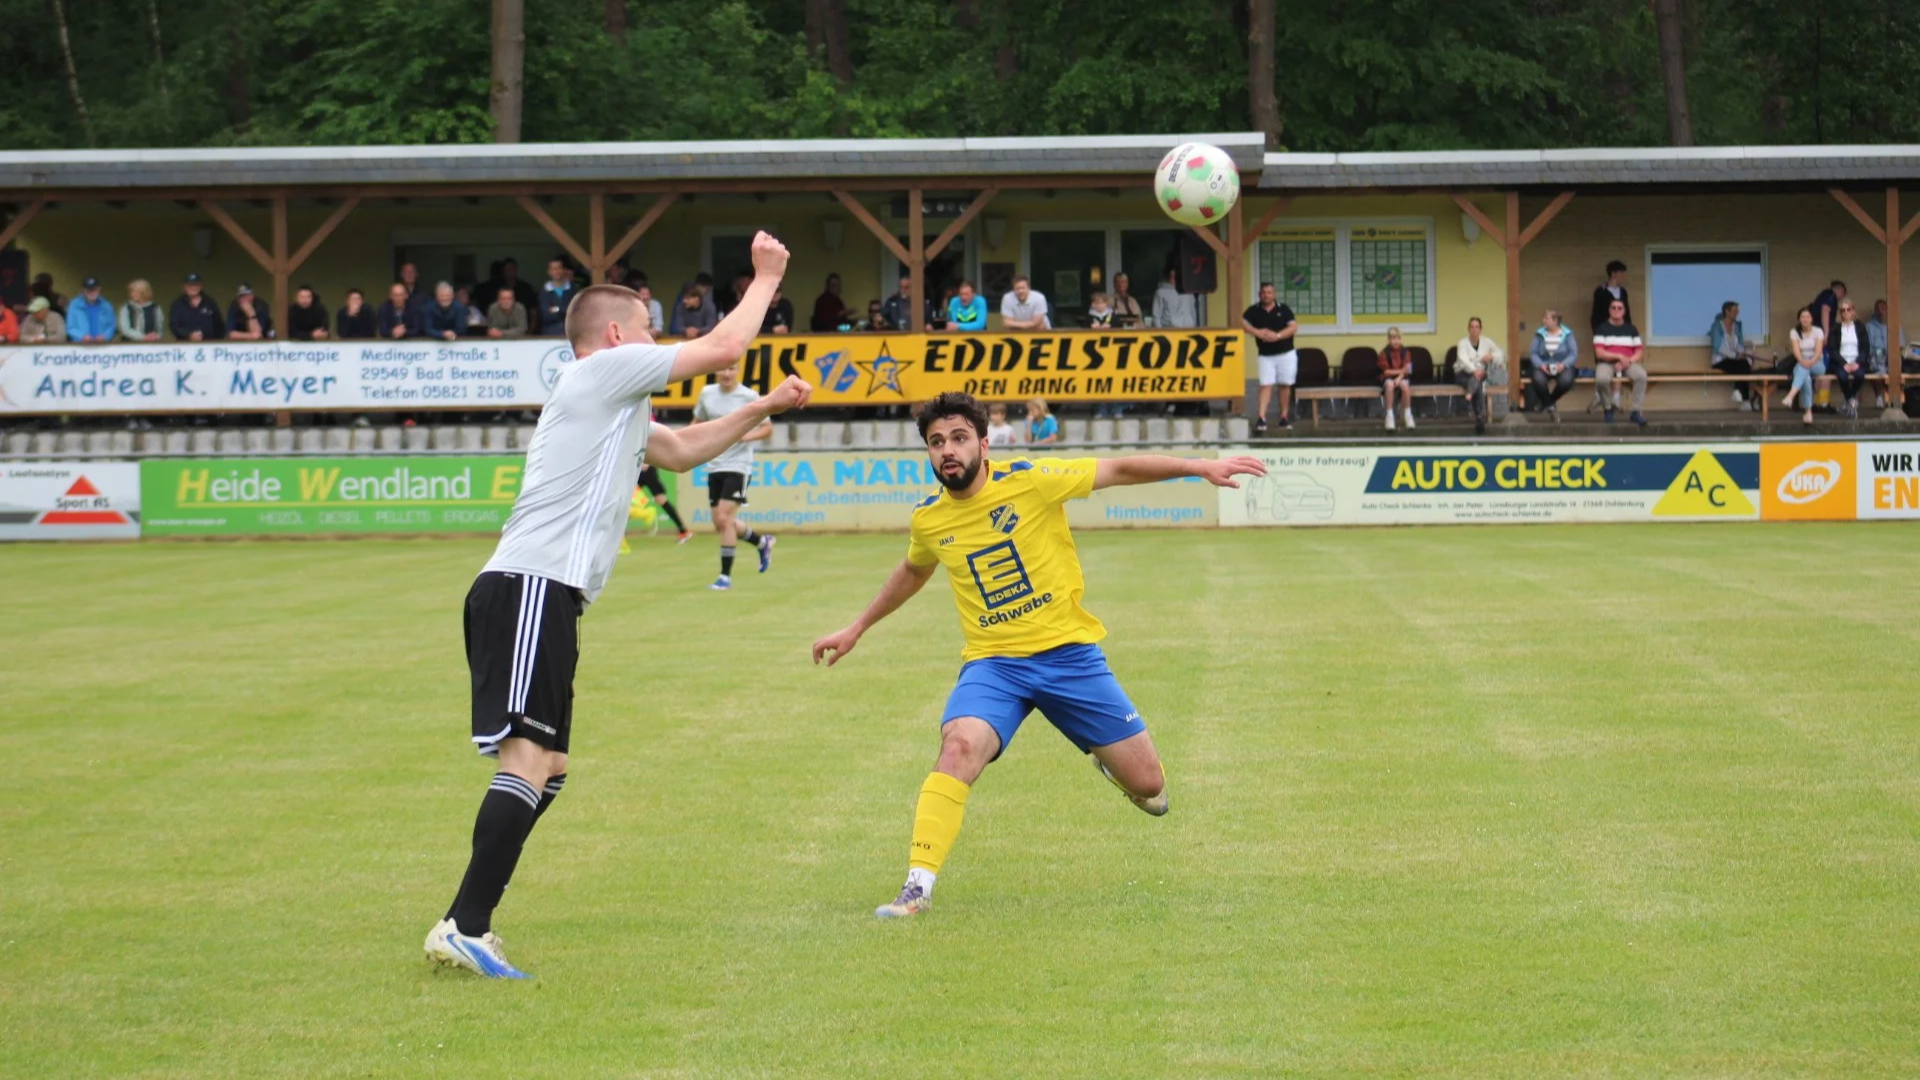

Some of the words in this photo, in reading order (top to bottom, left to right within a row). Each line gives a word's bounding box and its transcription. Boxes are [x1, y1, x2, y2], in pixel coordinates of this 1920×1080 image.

[33, 347, 186, 369] Krankengymnastik
[194, 348, 205, 363] &
[214, 346, 340, 366] Physiotherapie
[360, 347, 430, 365] Medinger
[437, 347, 488, 361] Straße
[492, 348, 500, 361] 1
[924, 334, 1238, 372] EDDELSTORF
[360, 367, 409, 381] 29549
[416, 367, 443, 380] Bad
[451, 367, 519, 380] Bevensen
[964, 377, 1008, 395] DEN
[1085, 376, 1113, 394] IM
[1121, 374, 1207, 394] HERZEN
[35, 371, 157, 398] Andrea
[176, 368, 207, 396] K.
[229, 368, 338, 403] Meyer
[361, 384, 419, 399] Telefon
[422, 384, 468, 398] 05821
[477, 384, 516, 398] 2108
[1279, 455, 1294, 466] für
[1871, 453, 1913, 472] WIR
[177, 468, 282, 501] Heide
[298, 466, 472, 500] Wendland
[491, 464, 521, 499] E
[1391, 459, 1486, 490] AUTO
[1495, 458, 1608, 488] CHECK
[1684, 470, 1703, 493] A
[1791, 473, 1825, 492] UKA
[56, 497, 89, 511] Sport
[1708, 484, 1726, 507] C
[1105, 504, 1204, 522] Himbergen
[939, 535, 955, 547] JAKO
[988, 582, 1028, 604] EDEKA
[978, 592, 1053, 628] Schwabe
